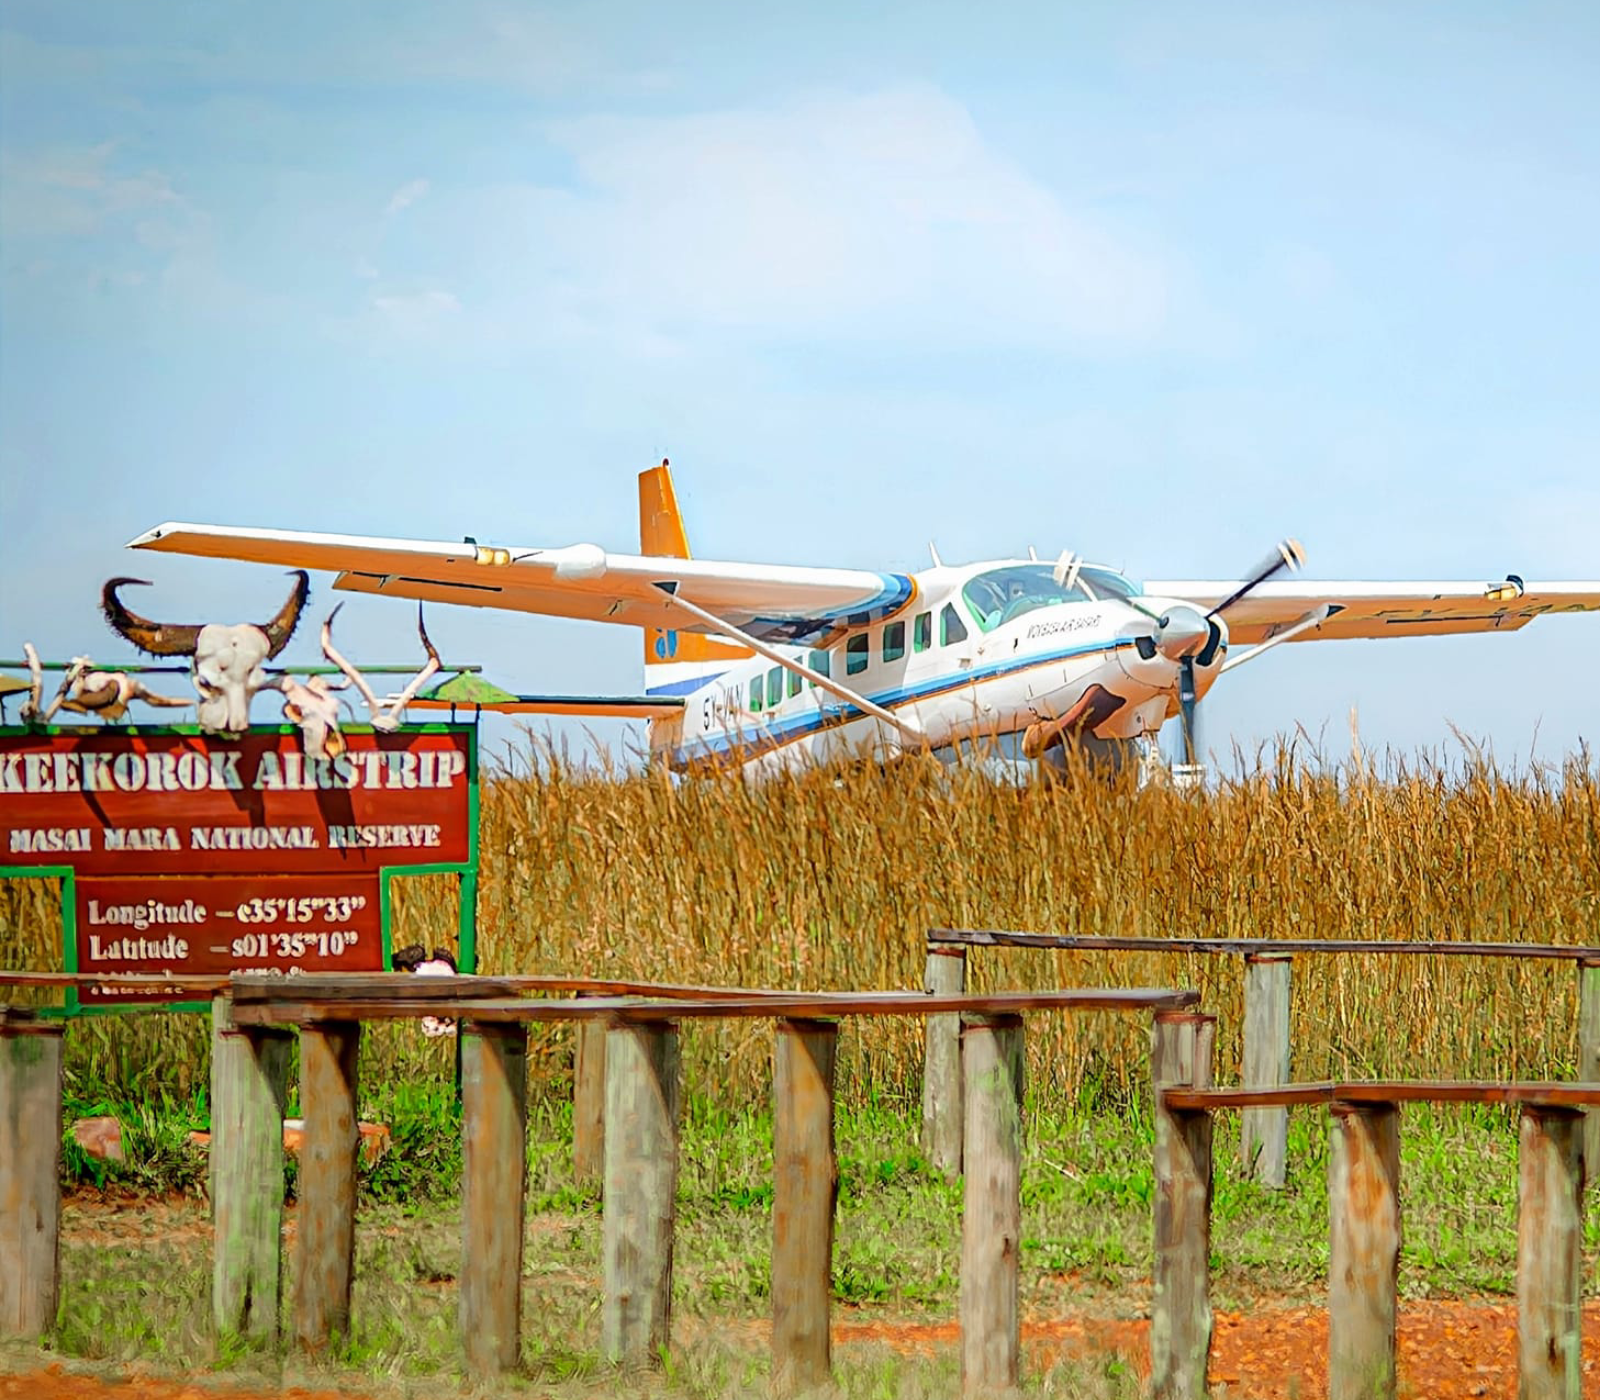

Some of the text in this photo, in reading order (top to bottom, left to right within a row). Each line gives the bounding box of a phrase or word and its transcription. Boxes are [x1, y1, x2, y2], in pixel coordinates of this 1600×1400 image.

[0, 751, 466, 792] KEEKOROK AIRSTRIP
[10, 825, 441, 852] MASAI MARA NATIONAL RESERVE
[88, 899, 207, 930] Longitude
[89, 933, 189, 960] Latitude
